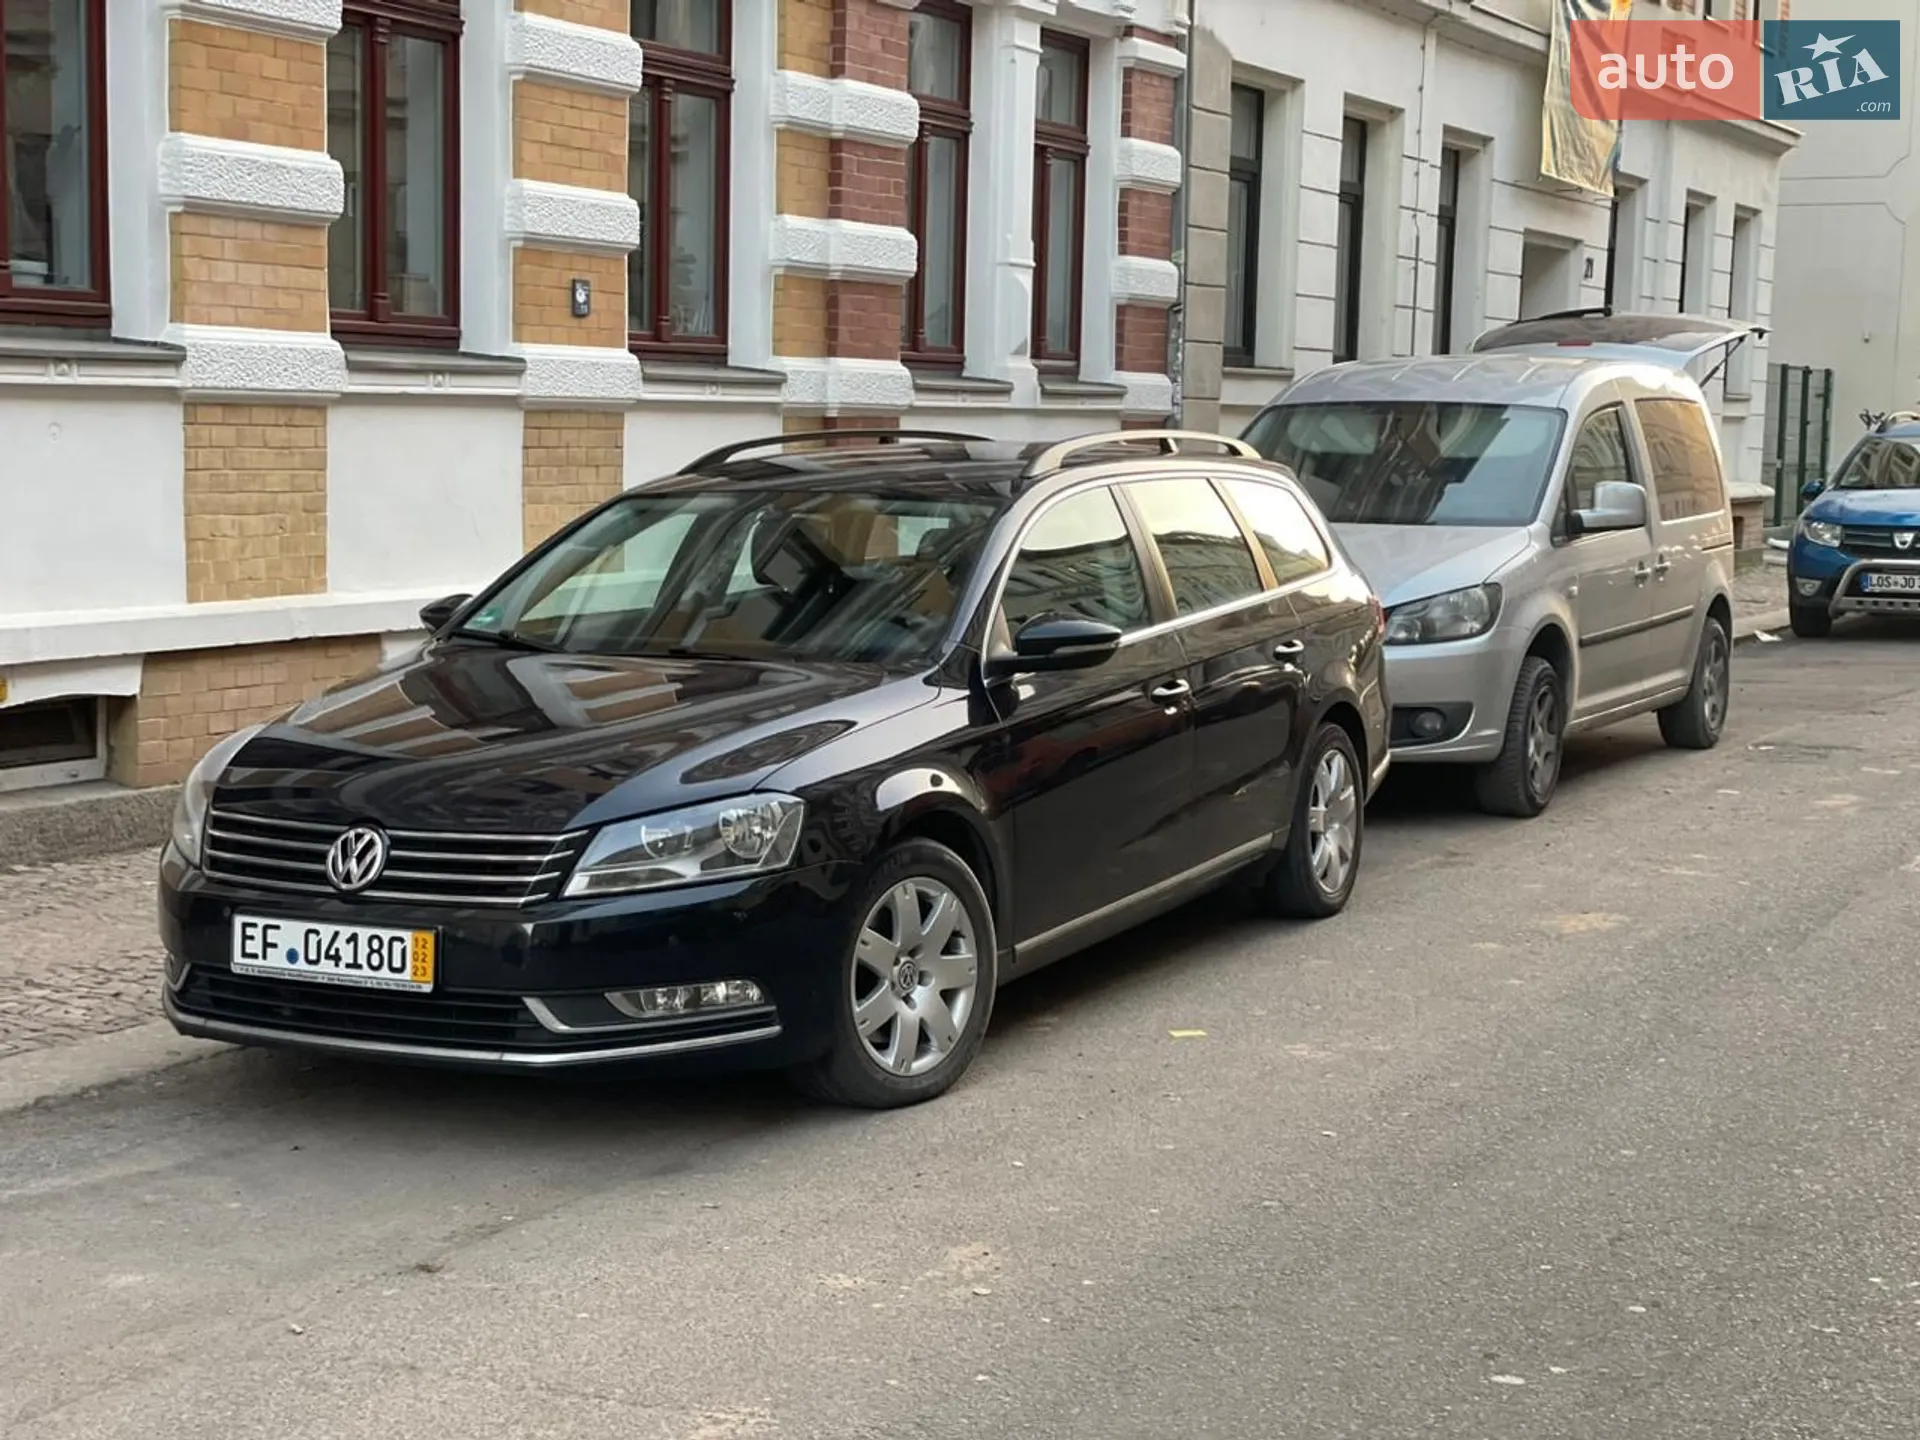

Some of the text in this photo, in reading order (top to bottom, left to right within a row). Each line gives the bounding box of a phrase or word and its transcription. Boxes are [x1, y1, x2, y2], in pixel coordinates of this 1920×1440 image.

[241, 922, 407, 974] EF 04180
[414, 936, 428, 949] 12
[412, 951, 428, 963] 02
[412, 965, 428, 977] 23
